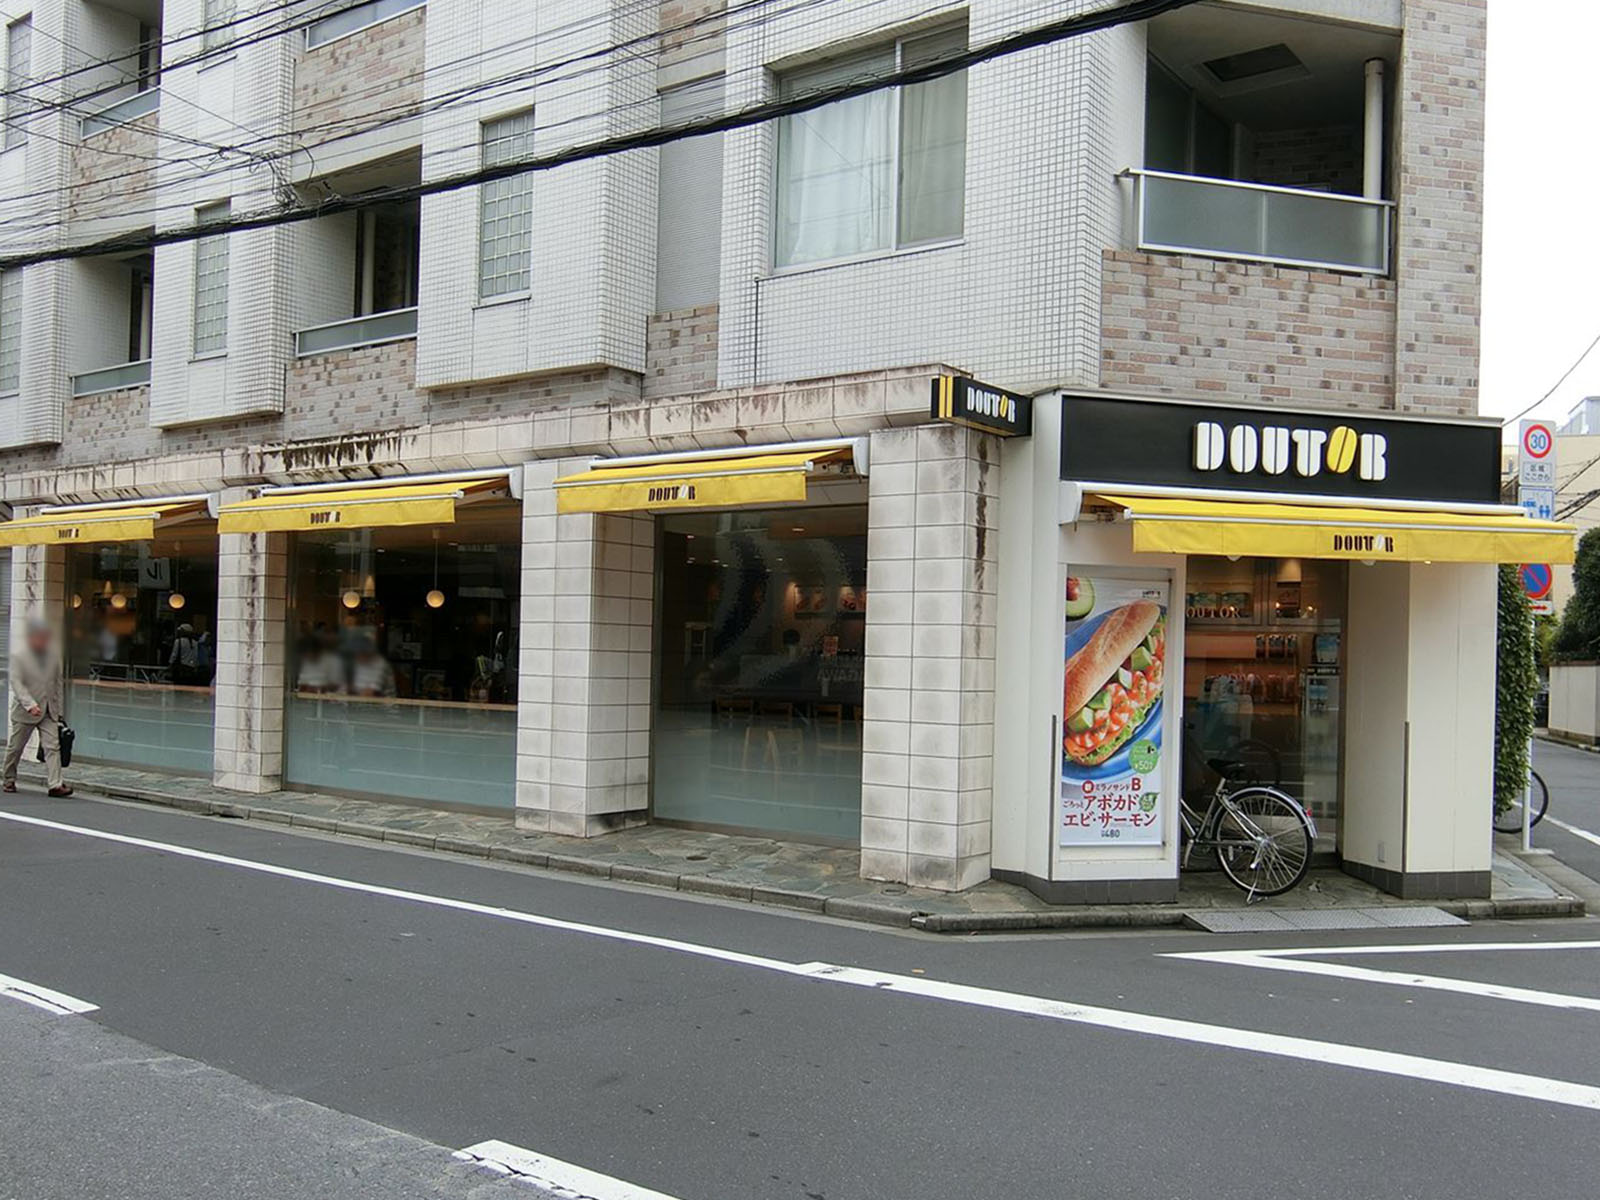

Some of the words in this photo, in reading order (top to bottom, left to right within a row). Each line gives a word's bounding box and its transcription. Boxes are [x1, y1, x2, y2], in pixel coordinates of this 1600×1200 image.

[967, 386, 1016, 423] DOUTOR
[1530, 433, 1547, 450] 30
[1194, 422, 1387, 481] DOUTOR
[648, 484, 696, 502] DOUTOR
[1333, 534, 1394, 552] DOUTOR
[1186, 606, 1241, 619] OUTOR
[1083, 791, 1139, 811] アボカド
[1063, 811, 1157, 828] エビ・サーモン
